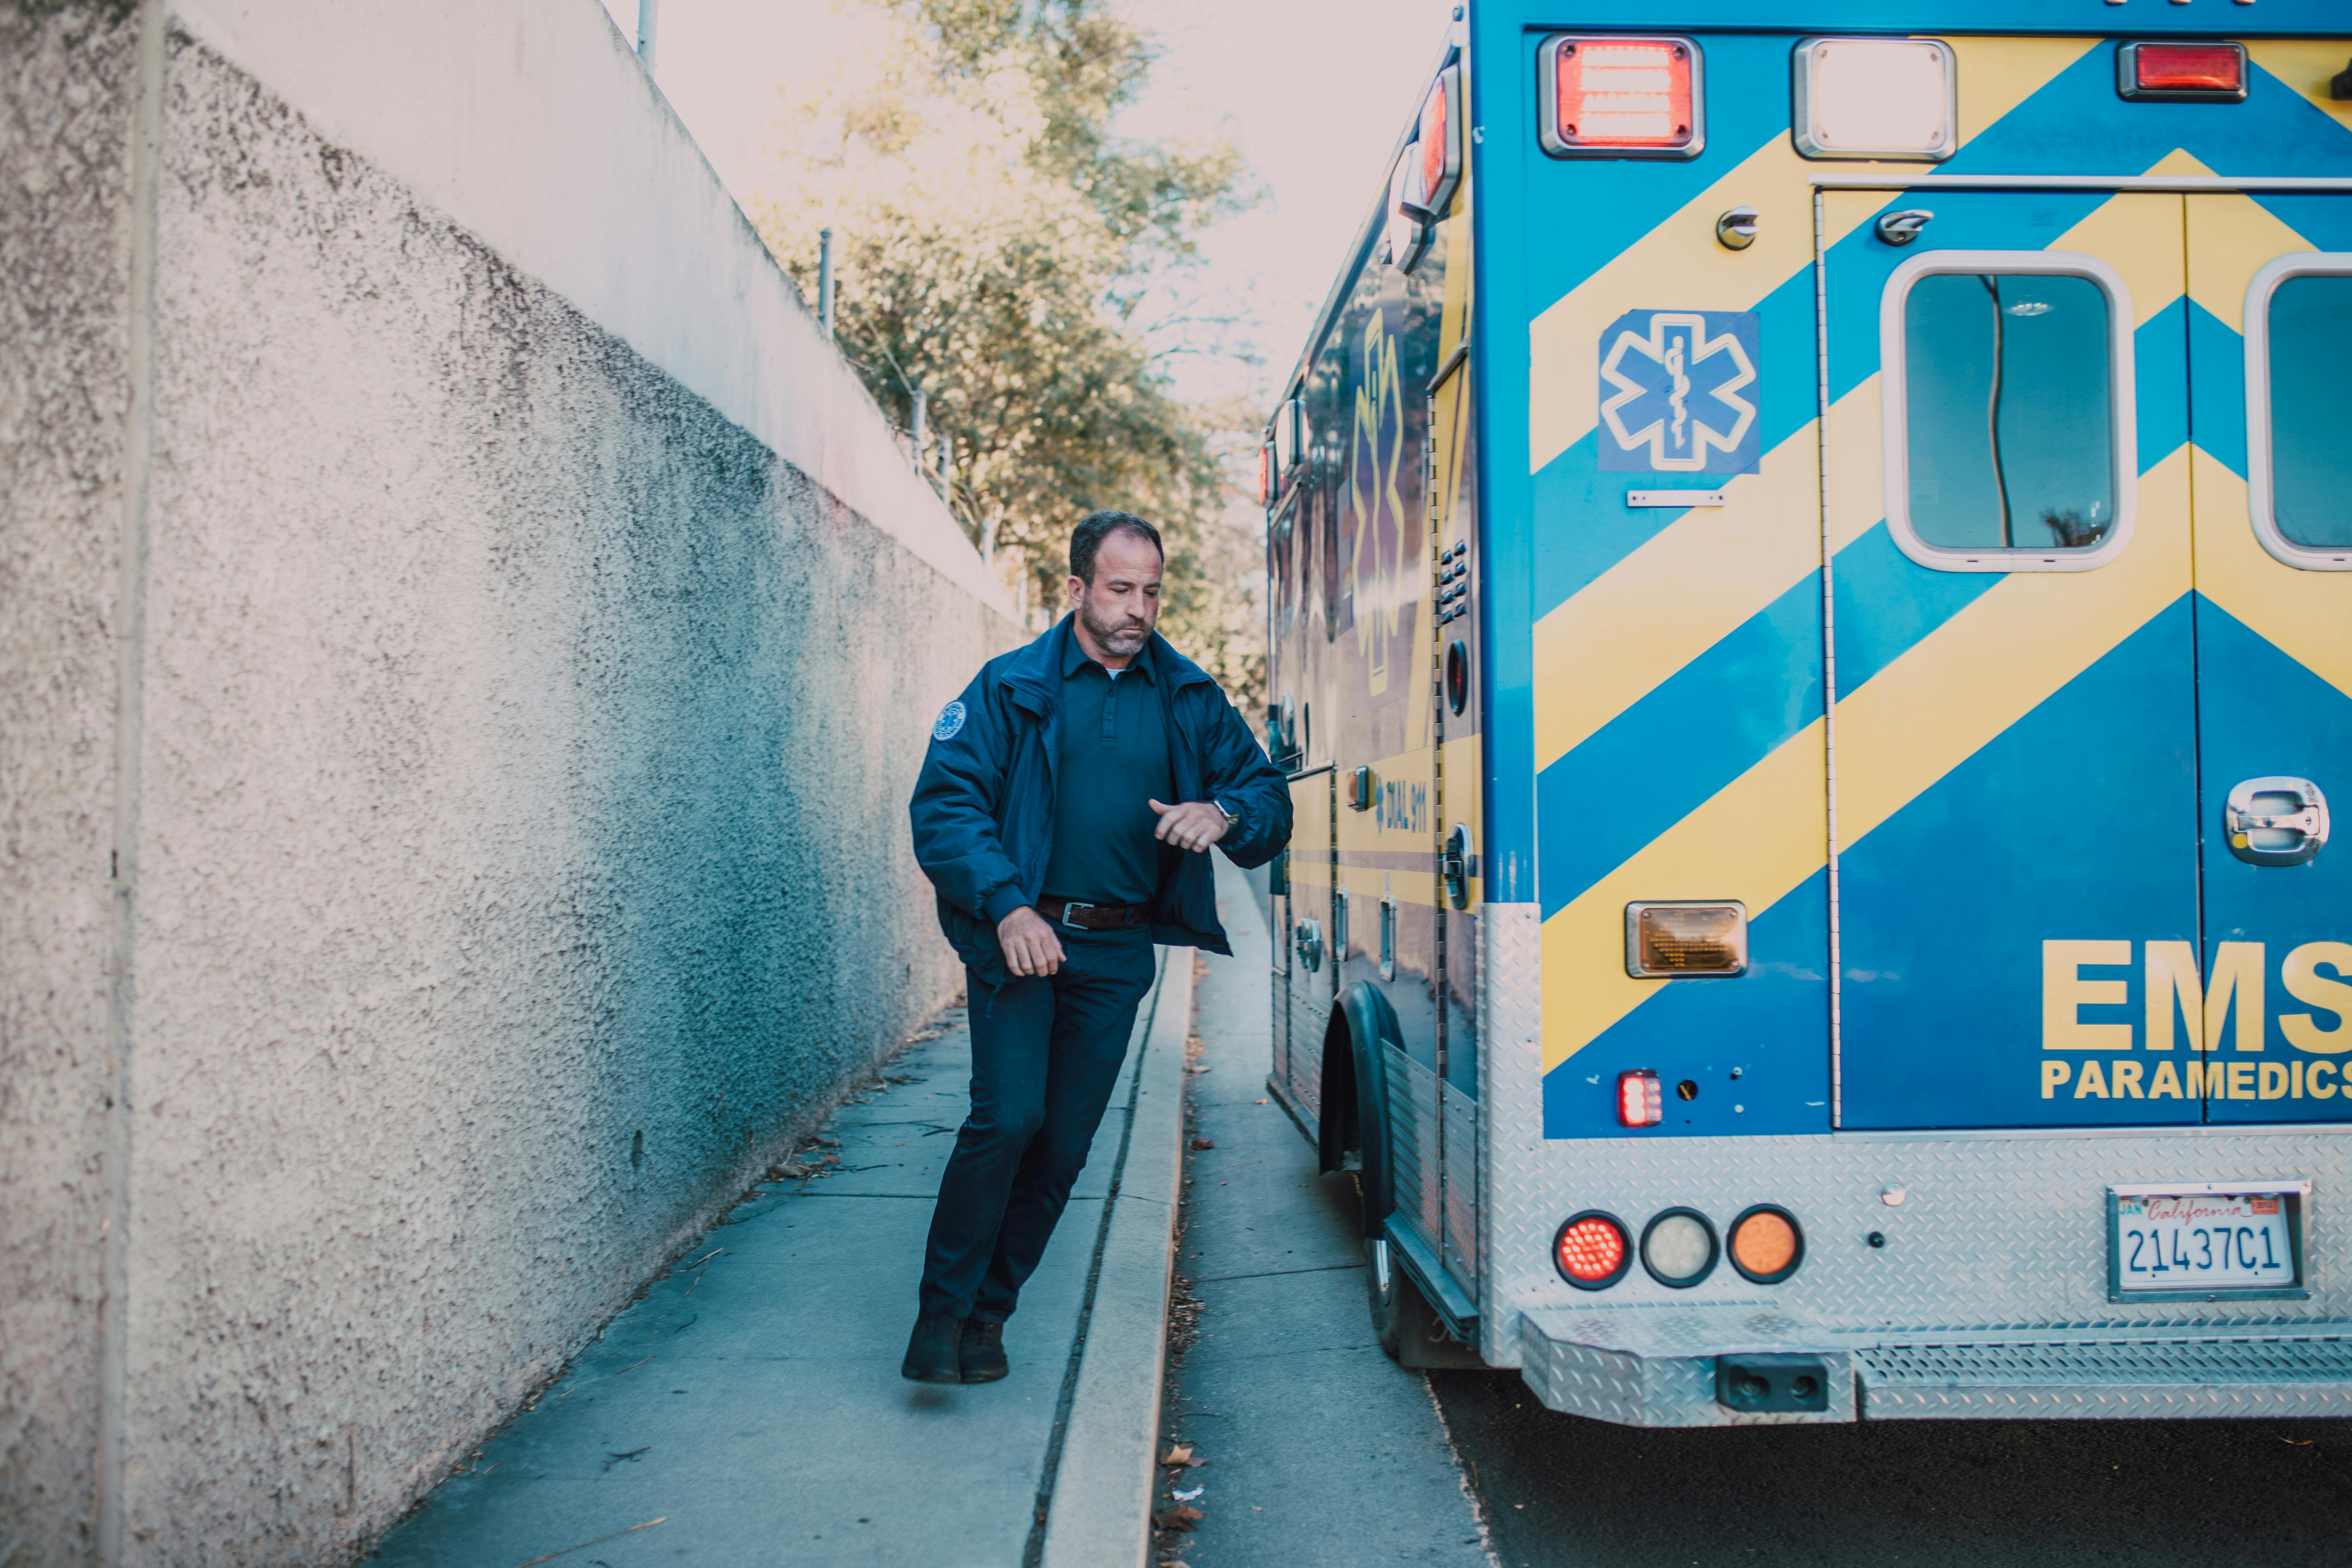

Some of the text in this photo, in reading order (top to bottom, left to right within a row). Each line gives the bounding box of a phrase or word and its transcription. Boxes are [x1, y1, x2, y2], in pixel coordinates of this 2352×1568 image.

[1387, 781, 1427, 833] DIAL 911
[2042, 940, 2352, 1054] EMS
[2120, 1203, 2142, 1215] JAN
[2148, 1200, 2254, 1226] California
[2127, 1226, 2280, 1272] 21437C1
